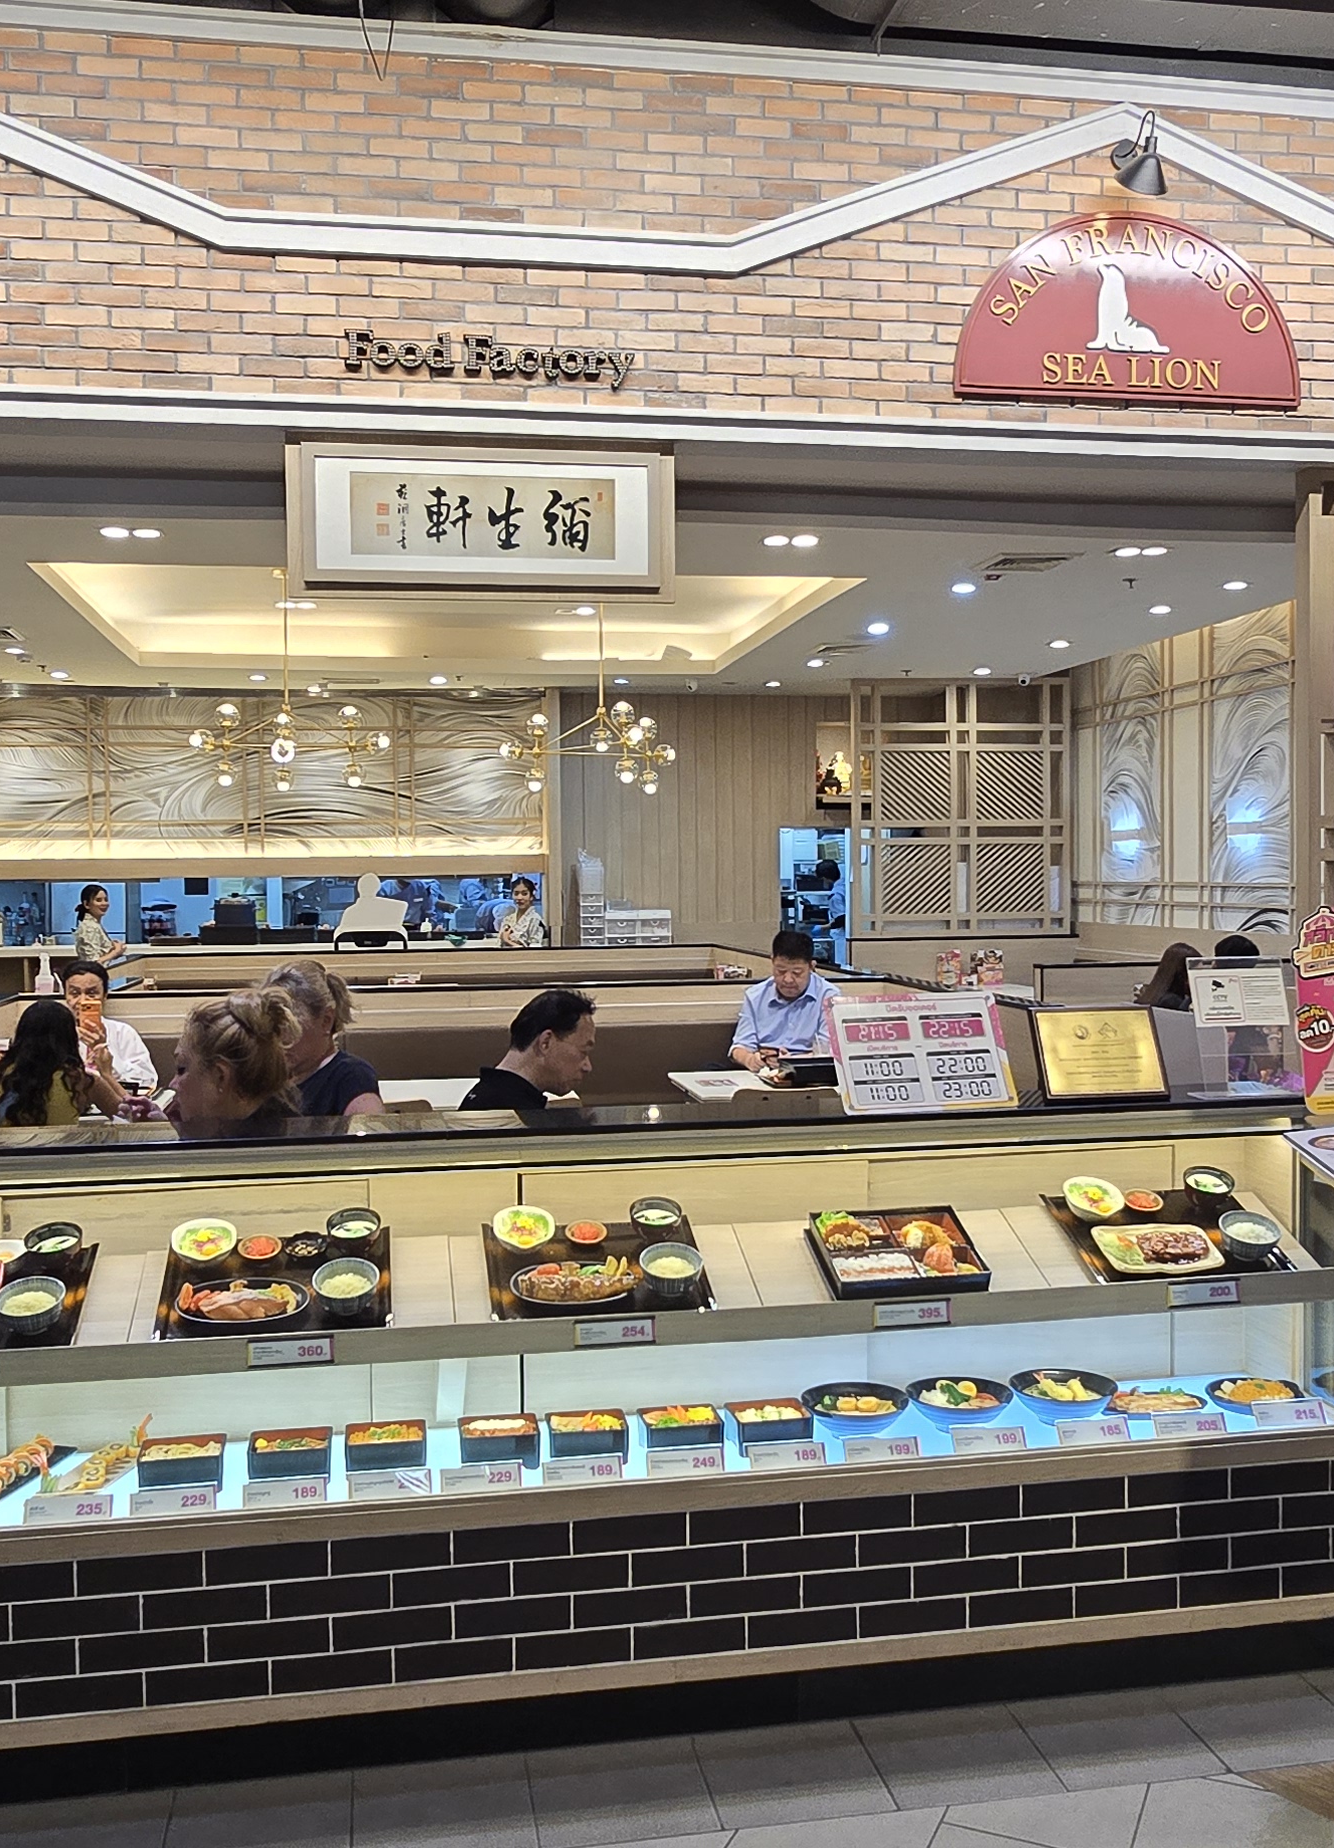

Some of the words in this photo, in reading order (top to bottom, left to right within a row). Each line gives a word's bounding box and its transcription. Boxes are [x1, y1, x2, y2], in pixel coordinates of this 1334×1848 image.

[988, 253, 1059, 327] SAN
[1060, 223, 1270, 334] FRANCISCO
[343, 327, 456, 372] Food
[463, 332, 636, 392] Factory
[1042, 352, 1115, 386] SEA
[1127, 355, 1221, 391] LION
[928, 1020, 974, 1038] 22:15
[863, 1059, 904, 1077] 11:00
[935, 1055, 988, 1075] 22:00
[868, 1084, 911, 1102] 11:00
[942, 1079, 993, 1099] 23:00
